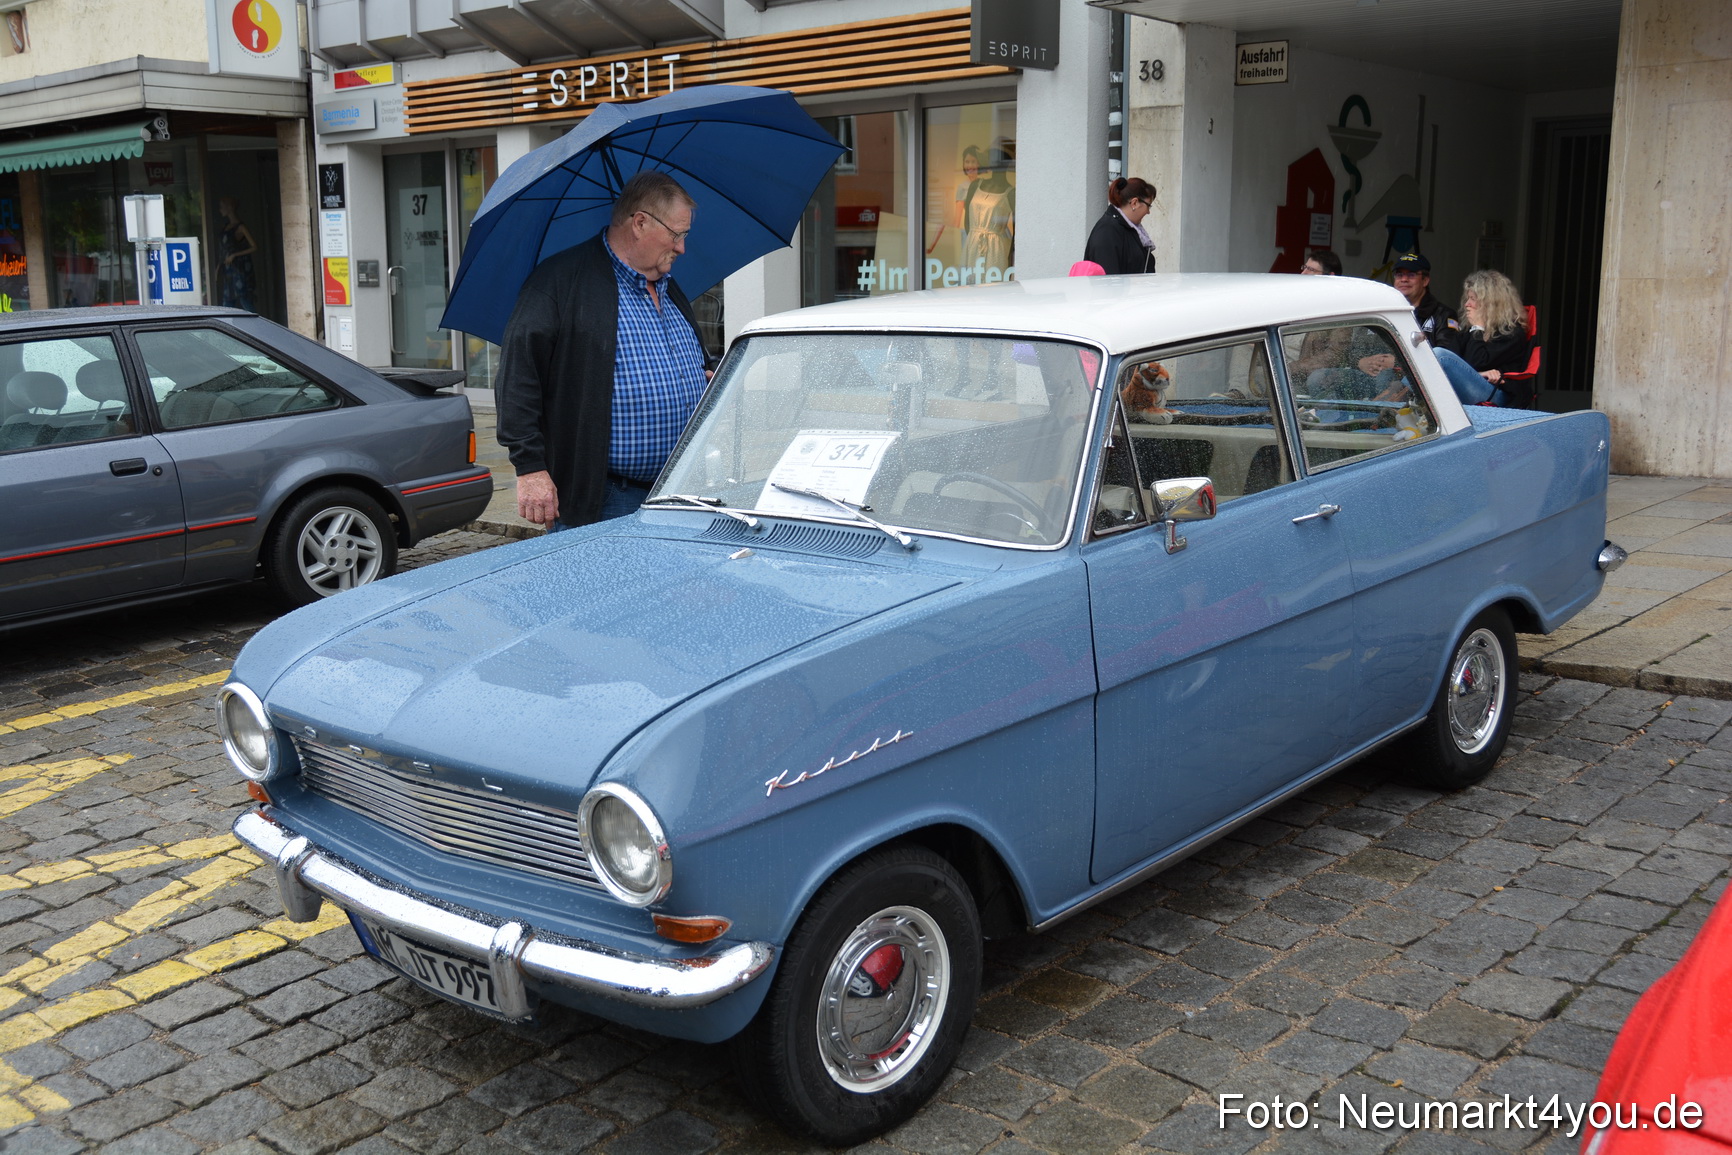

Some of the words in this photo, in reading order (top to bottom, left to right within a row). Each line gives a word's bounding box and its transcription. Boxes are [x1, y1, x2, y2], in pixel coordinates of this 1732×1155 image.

[989, 41, 1047, 61] ESPRIT
[1240, 48, 1285, 64] Ausfahrt
[1139, 59, 1163, 81] 38
[1239, 67, 1284, 79] freihalten
[522, 53, 681, 109] ESPRIT
[322, 105, 360, 121] Barmenia
[412, 194, 428, 216] 37
[172, 249, 187, 272] P
[828, 444, 870, 461] 374
[406, 945, 444, 989] DT
[443, 961, 497, 1006] 997
